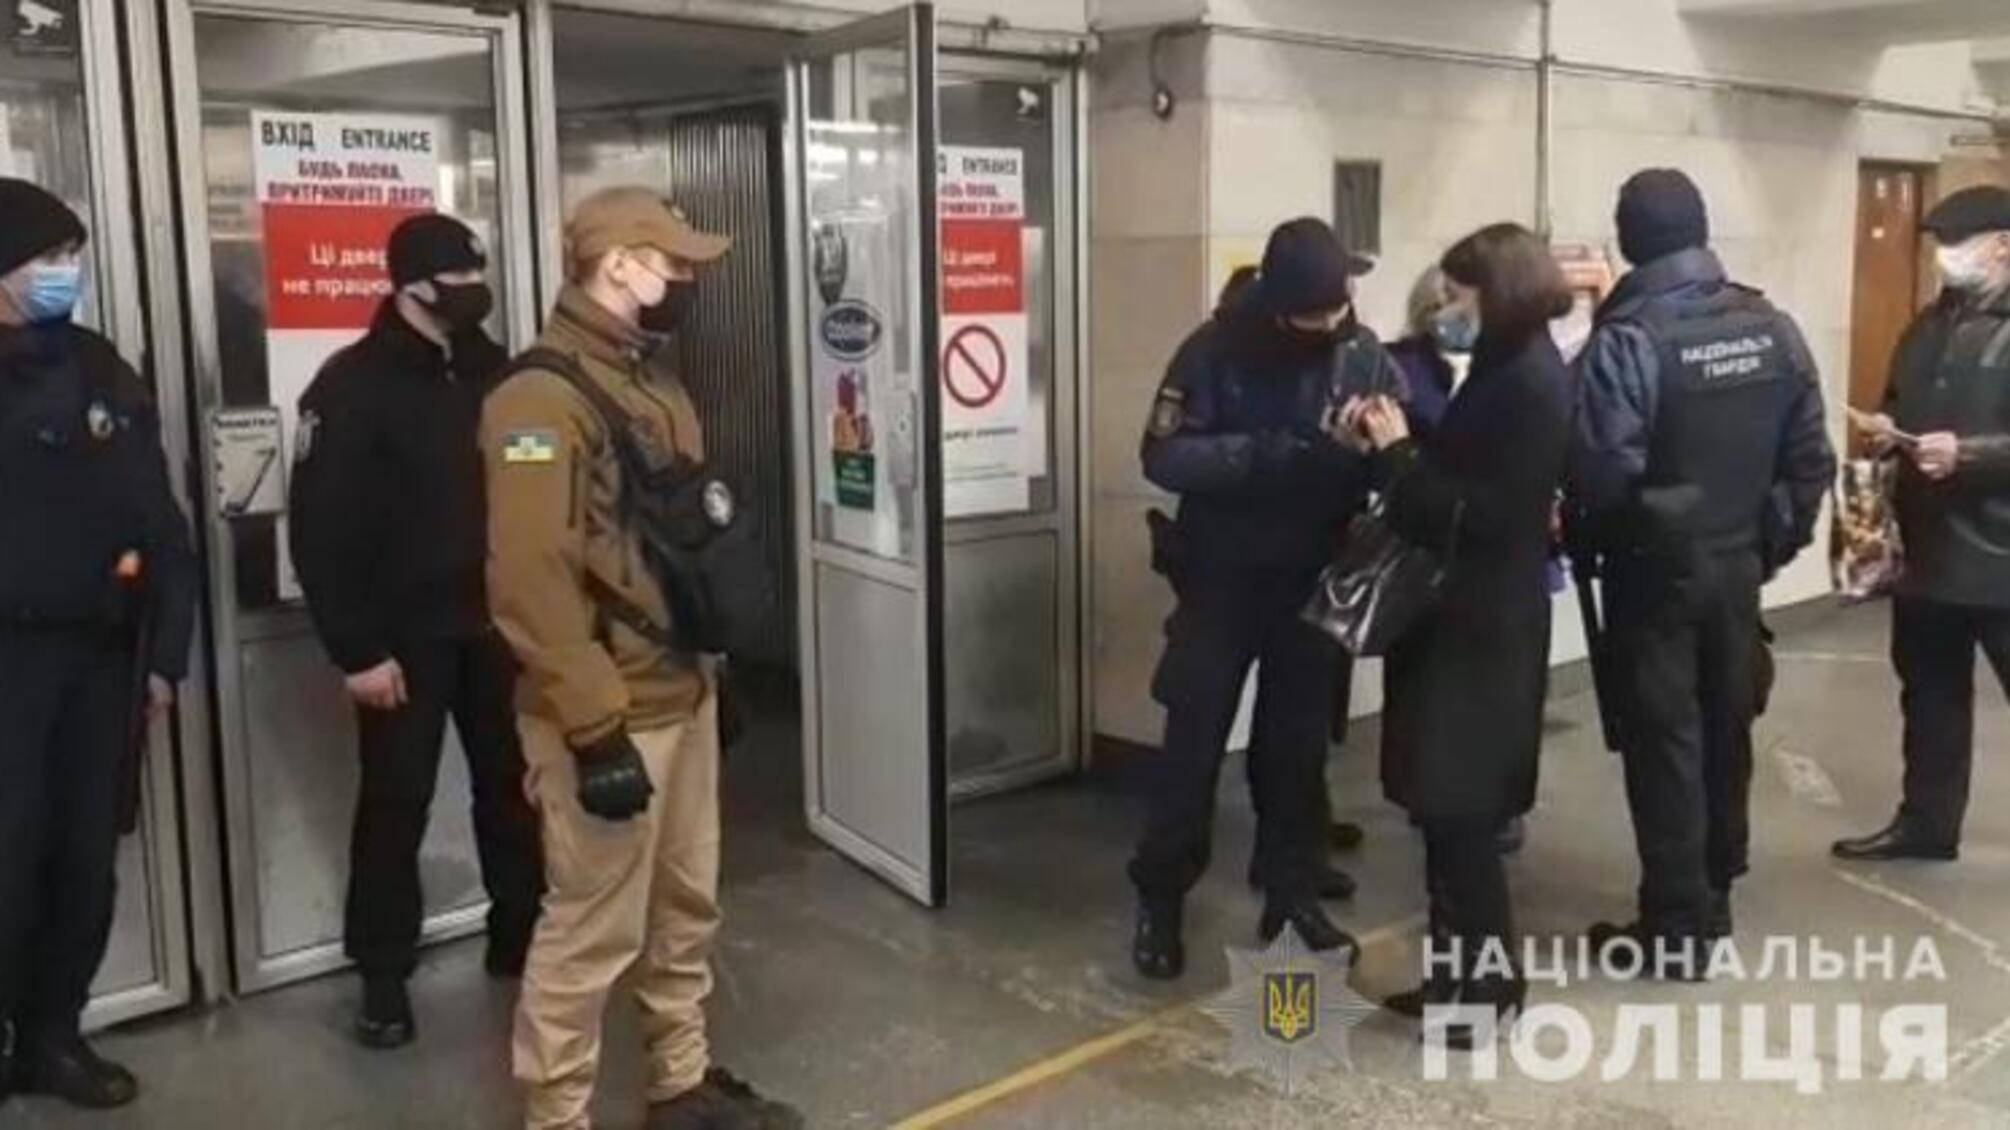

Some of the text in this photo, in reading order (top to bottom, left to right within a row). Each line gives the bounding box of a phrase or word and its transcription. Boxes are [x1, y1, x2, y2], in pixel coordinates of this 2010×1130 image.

[261, 121, 315, 151] ВХІД
[342, 128, 431, 152] ENTRANCE
[282, 279, 310, 295] не
